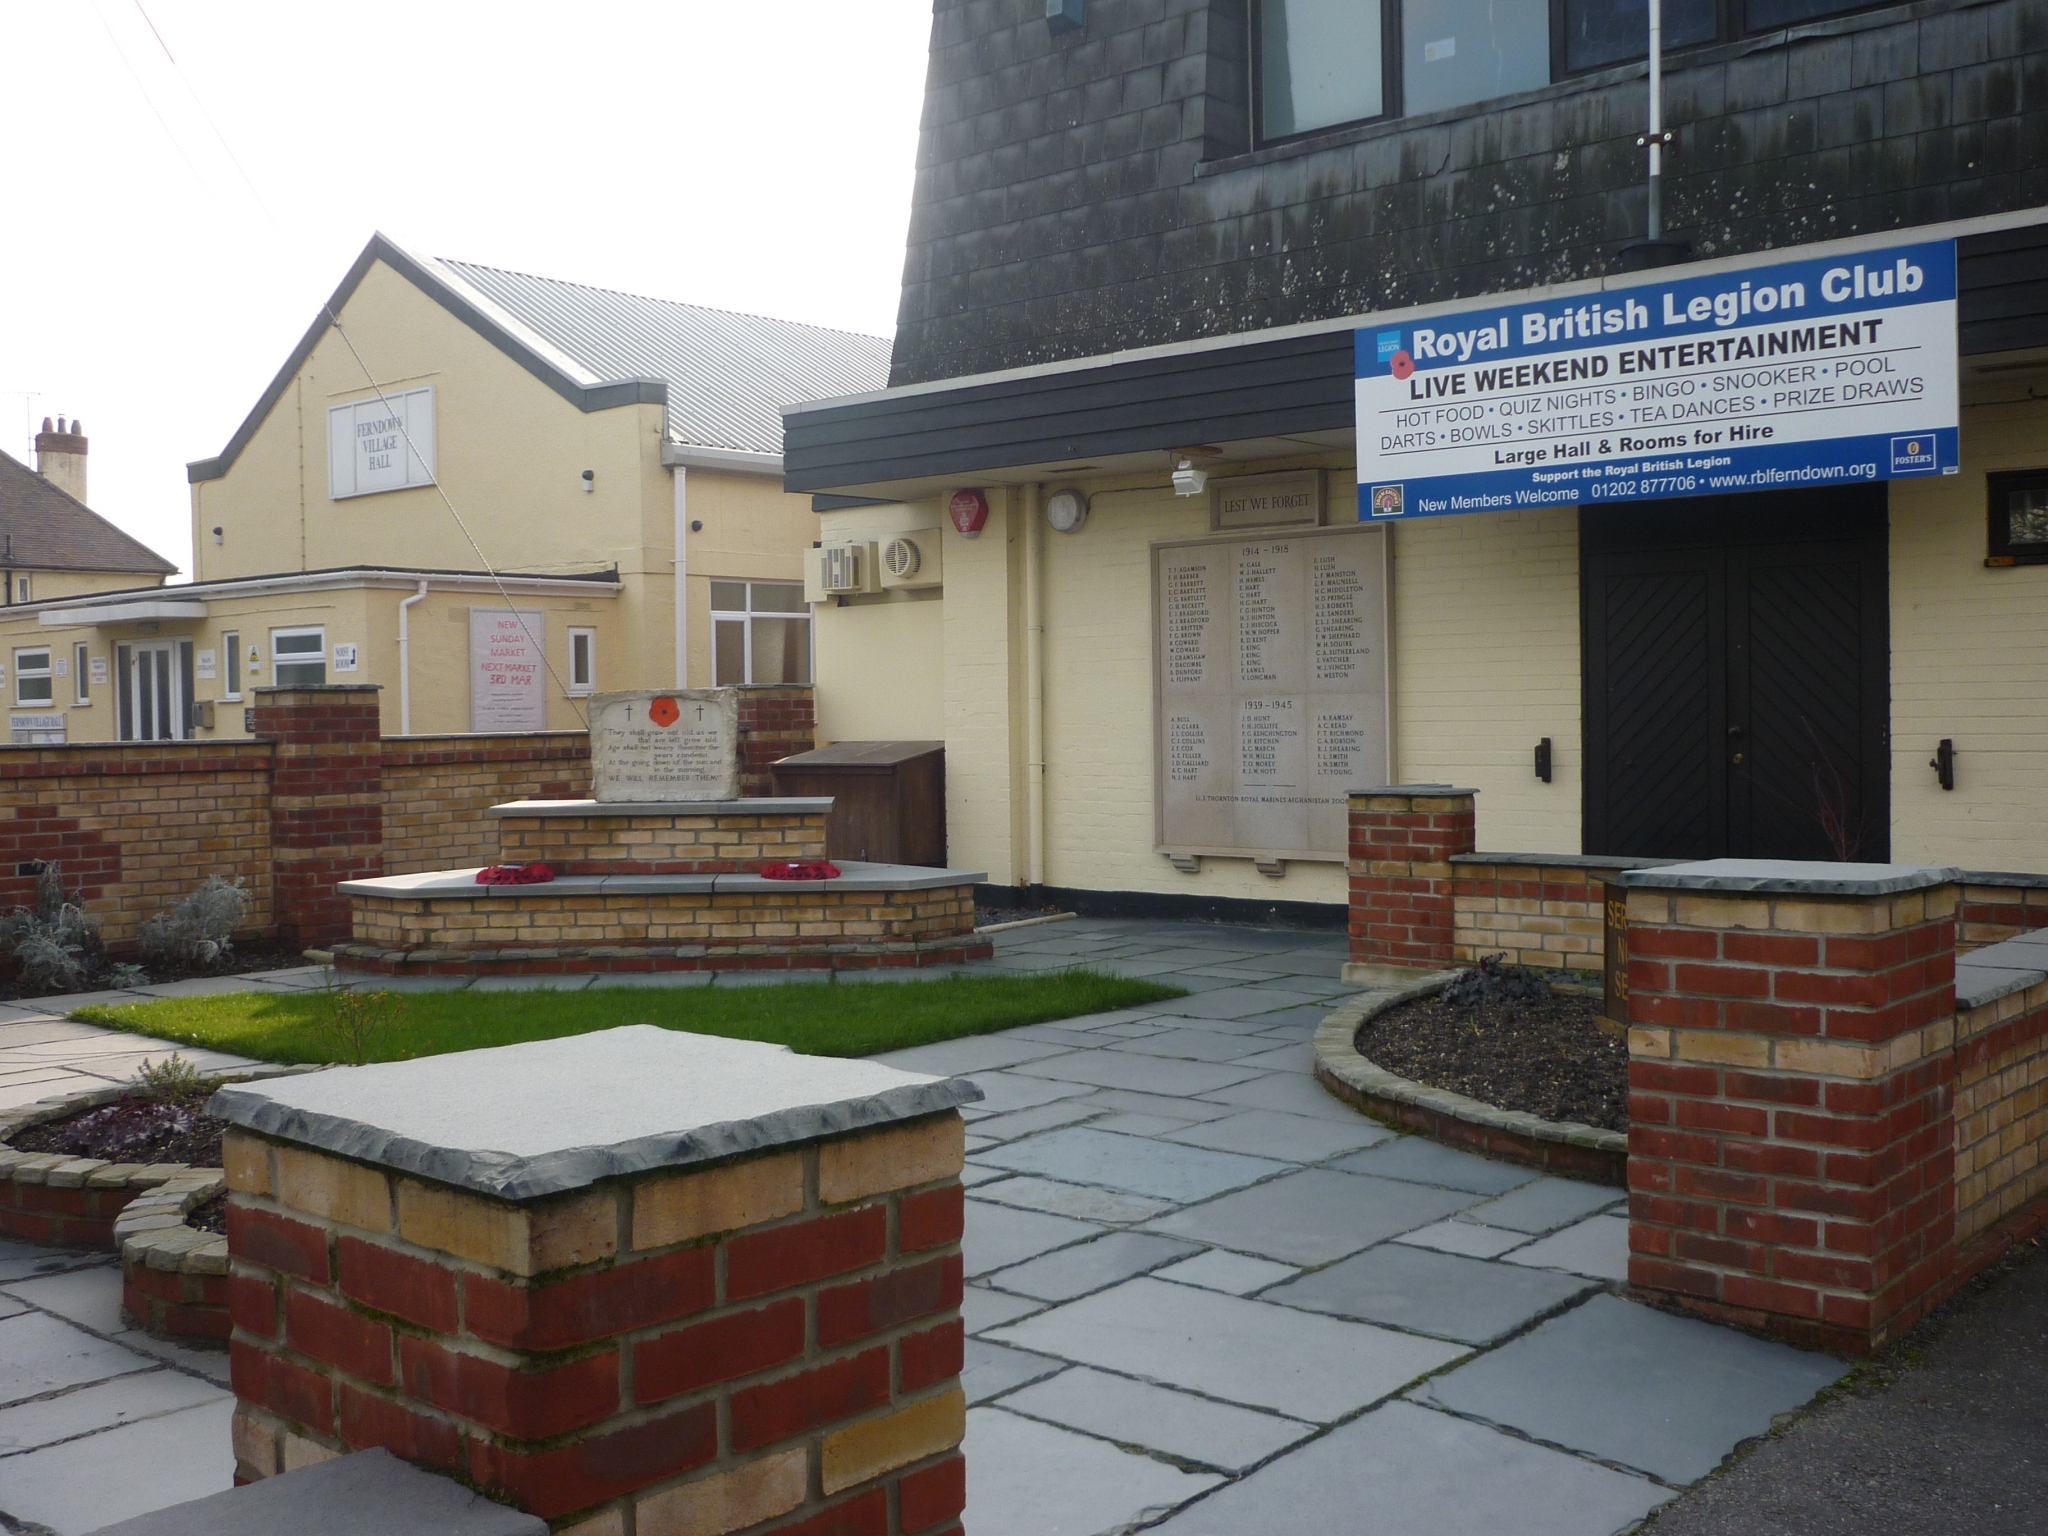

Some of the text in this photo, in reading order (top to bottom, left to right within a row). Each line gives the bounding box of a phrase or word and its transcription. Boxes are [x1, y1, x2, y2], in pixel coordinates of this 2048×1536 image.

[1413, 259, 1923, 361] Royal British Legion Club
[1379, 344, 1399, 352] LEGION
[1410, 318, 1882, 400] LIVE WEEKEND ENTERTAINMENT
[1396, 358, 1896, 428] HOT FOOD QUIZ NIGHTS BINGO SNOOKER POOL
[1381, 377, 1923, 450] DARTS BOWLS SKITTLES TEA DANCES PRIZE DRAWS
[363, 435, 397, 453] VILLAGE
[1495, 425, 1773, 465] Large Hall & Rooms for Hire
[369, 454, 391, 470] HALL
[1532, 456, 1730, 483] Support the Royal British Legion
[1419, 463, 1876, 512] New Members Welcome 01202 877706 www.rblferndown.org
[1225, 494, 1309, 513] LEST WE FORGET
[1242, 547, 1259, 556] 1914
[1272, 545, 1288, 553] 1918
[498, 621, 517, 629] NEW
[491, 635, 525, 643] SUNDAY
[491, 648, 526, 657] MARKET
[481, 663, 537, 672] NEXT MARKET
[490, 675, 532, 685] 3RD MAR
[1245, 701, 1262, 709] 1939
[1272, 701, 1292, 709] 1945
